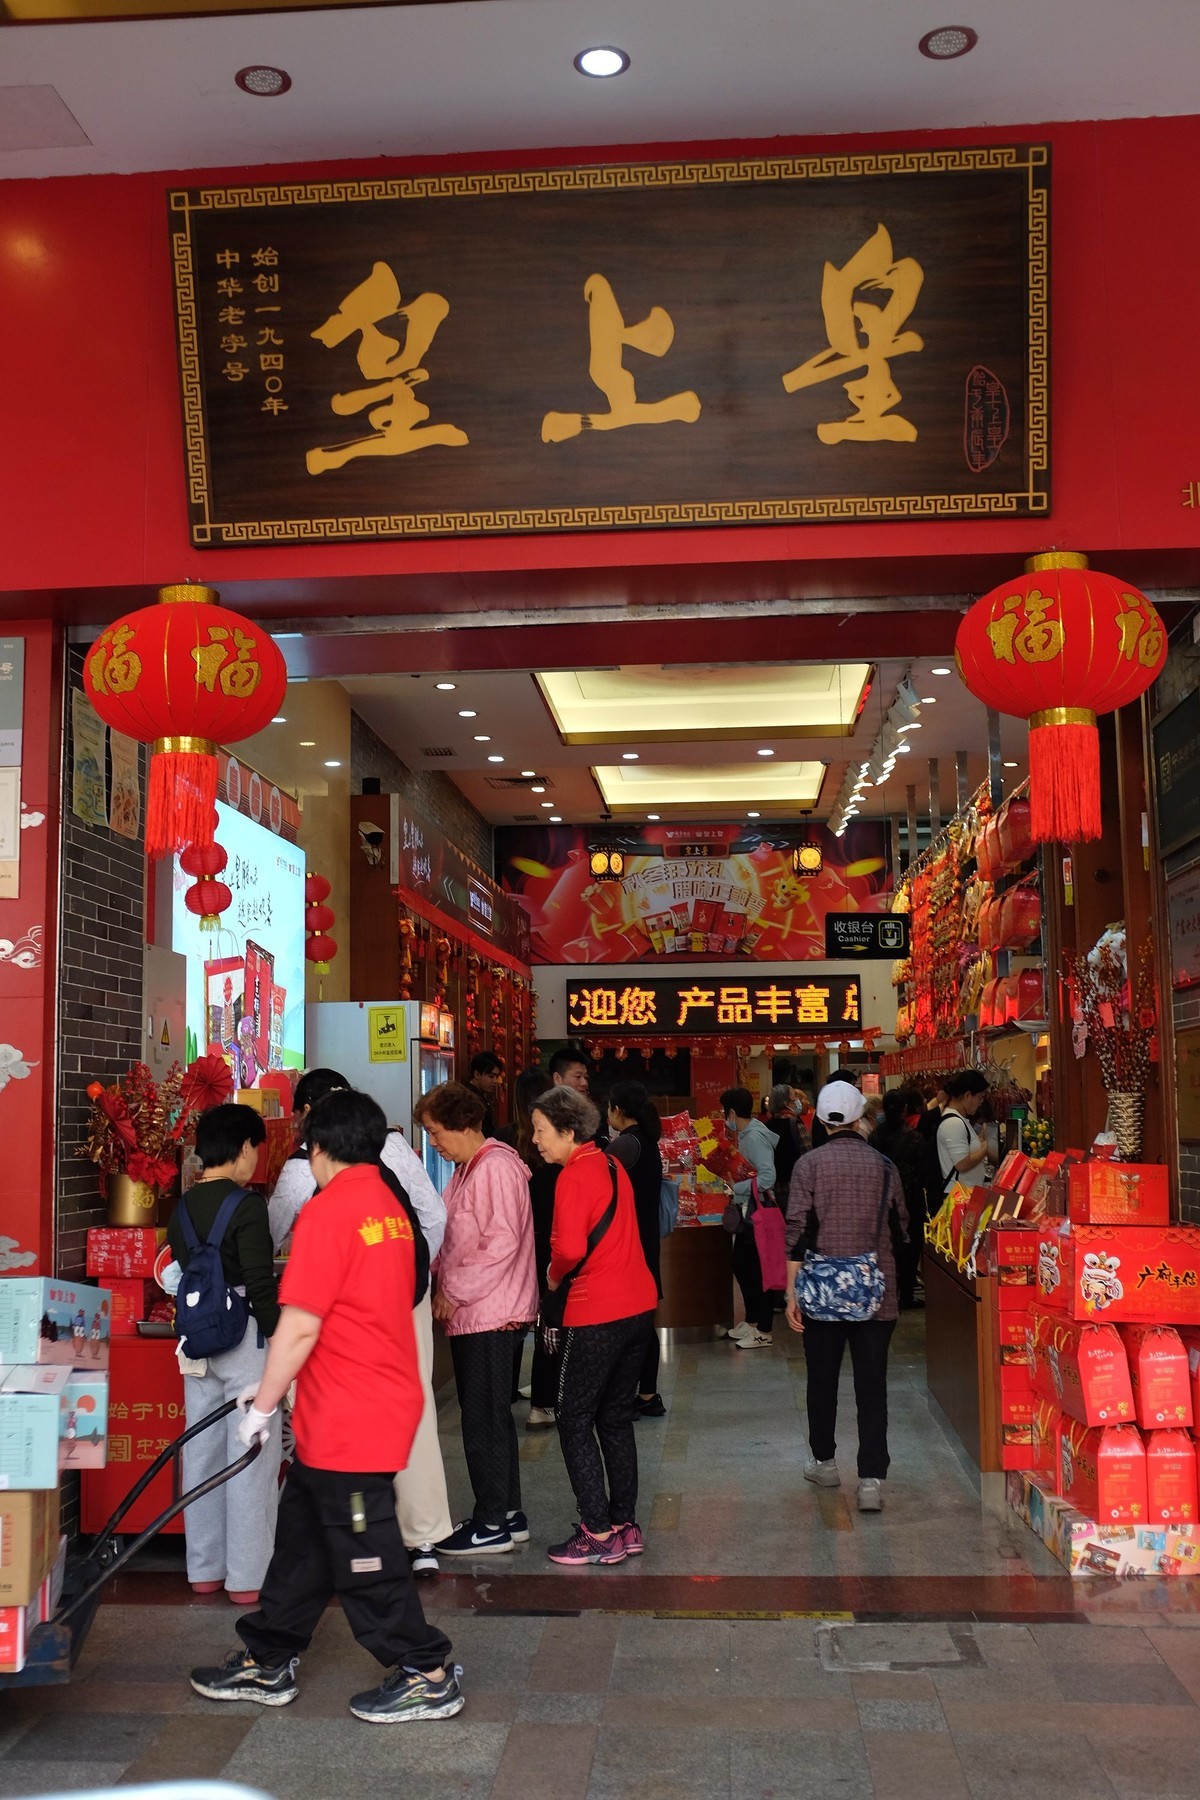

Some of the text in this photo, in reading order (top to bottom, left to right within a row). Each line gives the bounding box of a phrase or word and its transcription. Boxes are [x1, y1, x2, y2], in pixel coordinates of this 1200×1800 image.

[216, 249, 250, 382] 中华老字号
[306, 222, 925, 476] 皇上皇
[89, 623, 143, 696] 福
[190, 625, 263, 699] 福
[986, 589, 1065, 665] 福
[834, 921, 875, 934] 收银台
[677, 984, 830, 1026] 产品丰富
[1137, 1261, 1197, 1292] 广府手信
